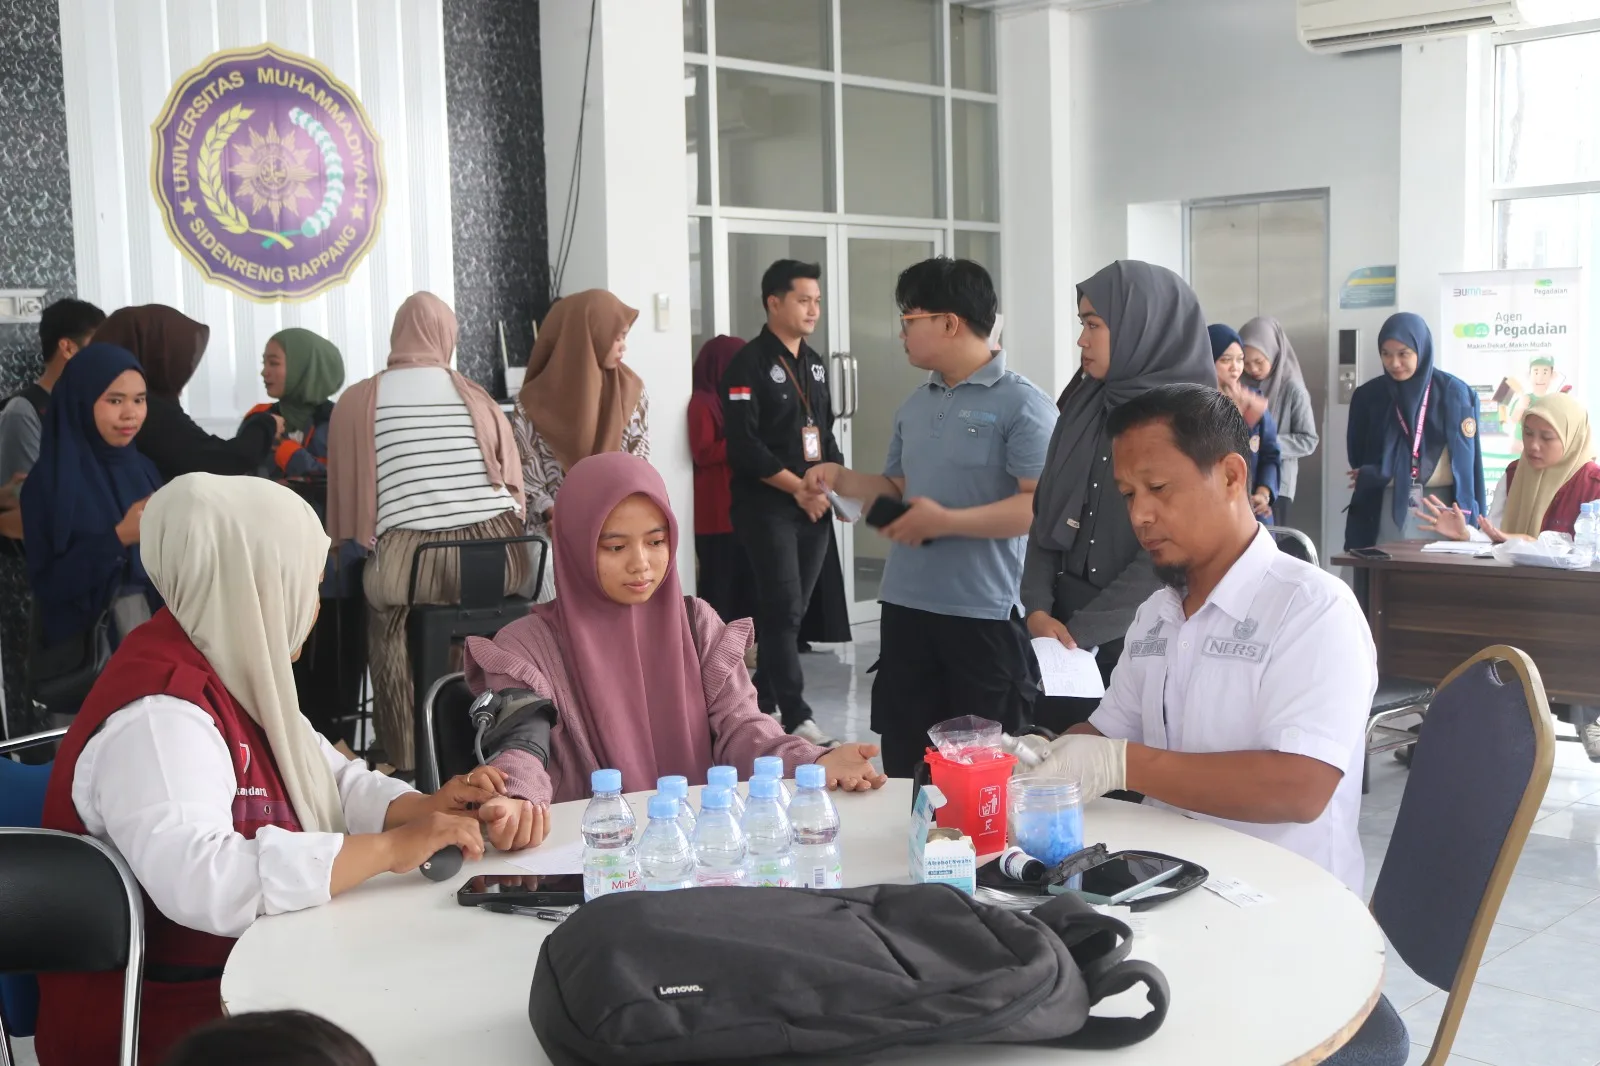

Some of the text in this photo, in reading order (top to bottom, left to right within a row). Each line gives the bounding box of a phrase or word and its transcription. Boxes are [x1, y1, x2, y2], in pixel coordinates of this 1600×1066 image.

[172, 67, 369, 199] UNIVERSITAS MUHAMMADIYAH
[189, 217, 357, 283] SIDENRENG RAPPANG
[1534, 287, 1568, 296] Pegadaian
[1495, 312, 1522, 323] Agen
[1494, 322, 1567, 339] Pegadaian
[1210, 642, 1257, 657] NERS
[628, 869, 637, 879] Le
[660, 985, 700, 995] Lenovo
